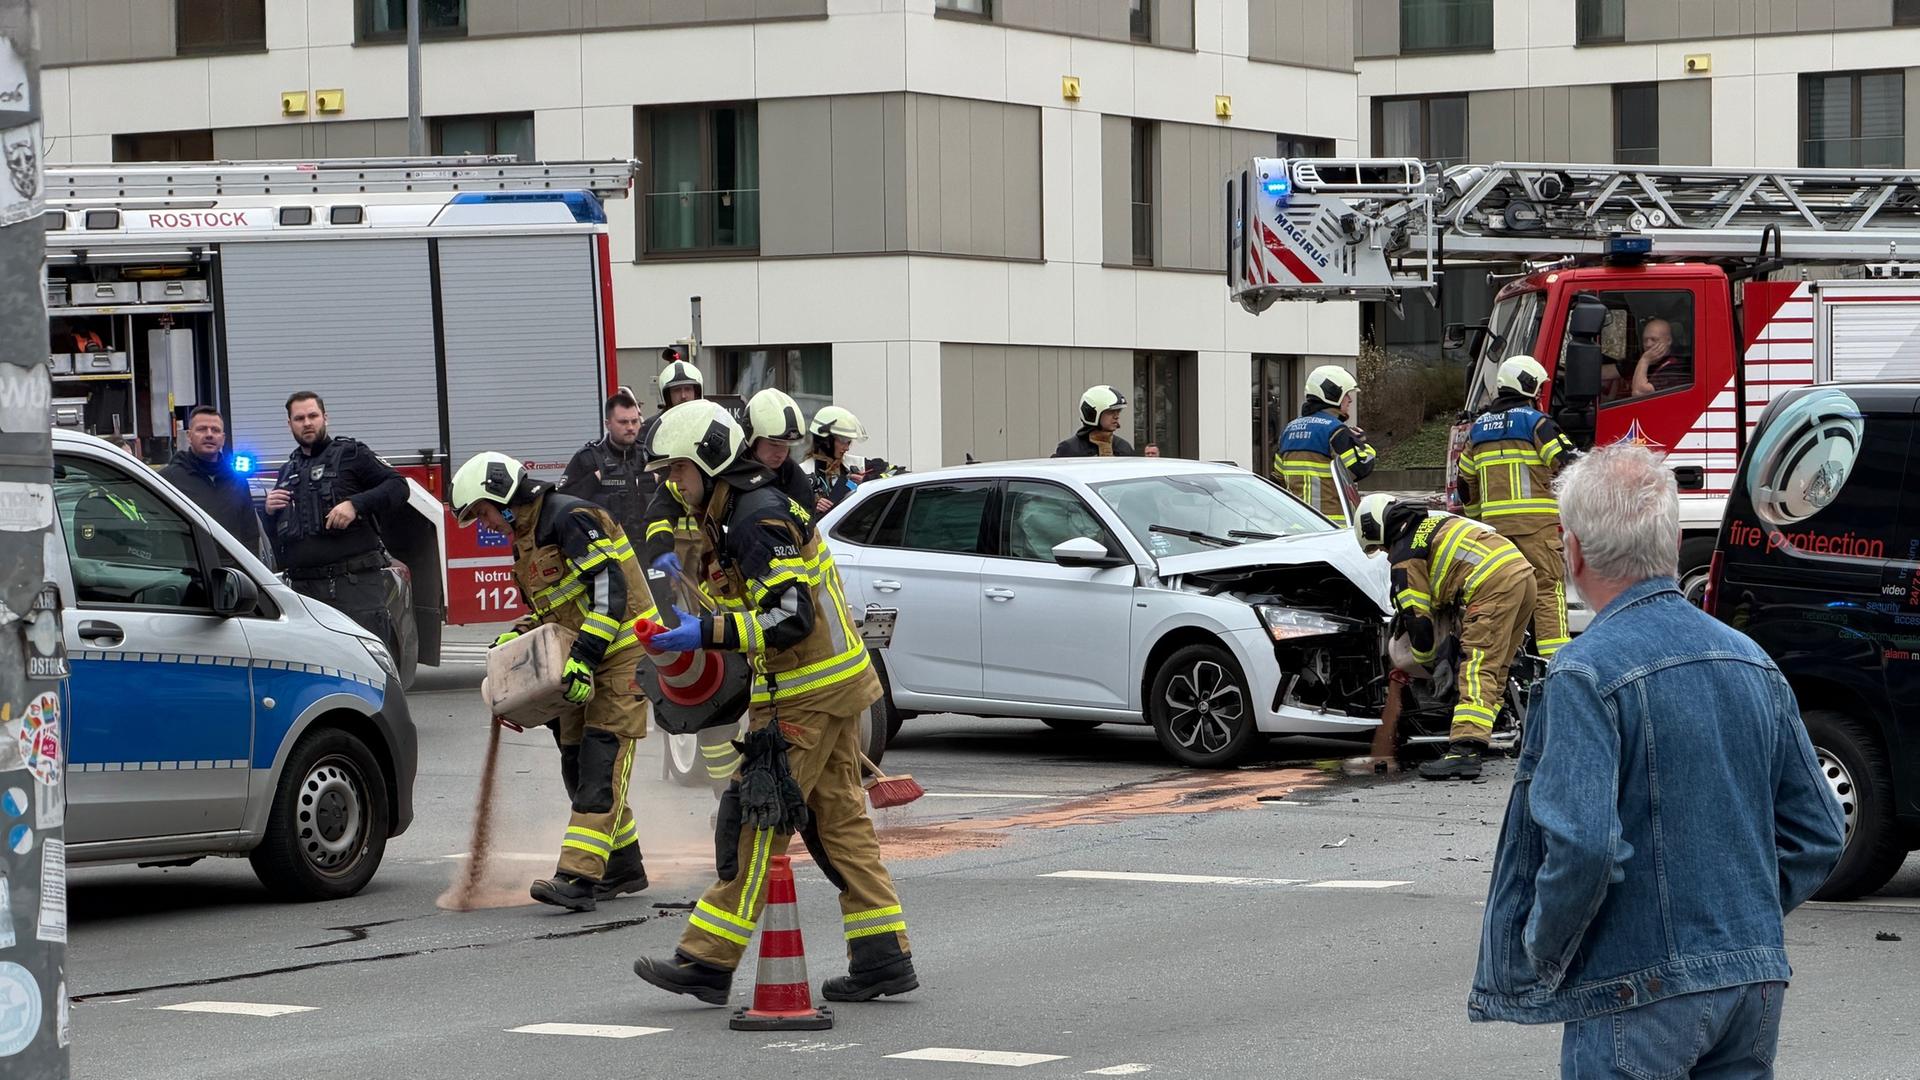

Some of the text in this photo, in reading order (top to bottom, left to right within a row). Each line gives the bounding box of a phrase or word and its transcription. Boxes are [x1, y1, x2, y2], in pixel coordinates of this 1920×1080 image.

[149, 212, 248, 228] ROSTOCK
[1274, 213, 1329, 268] MAGIRUS
[1730, 521, 1885, 559] fire protection
[475, 570, 512, 583] Notru
[1882, 584, 1906, 596] video
[475, 586, 518, 611] 112
[1866, 601, 1900, 613] security
[1894, 615, 1920, 625] acces
[1885, 648, 1910, 660] alarm
